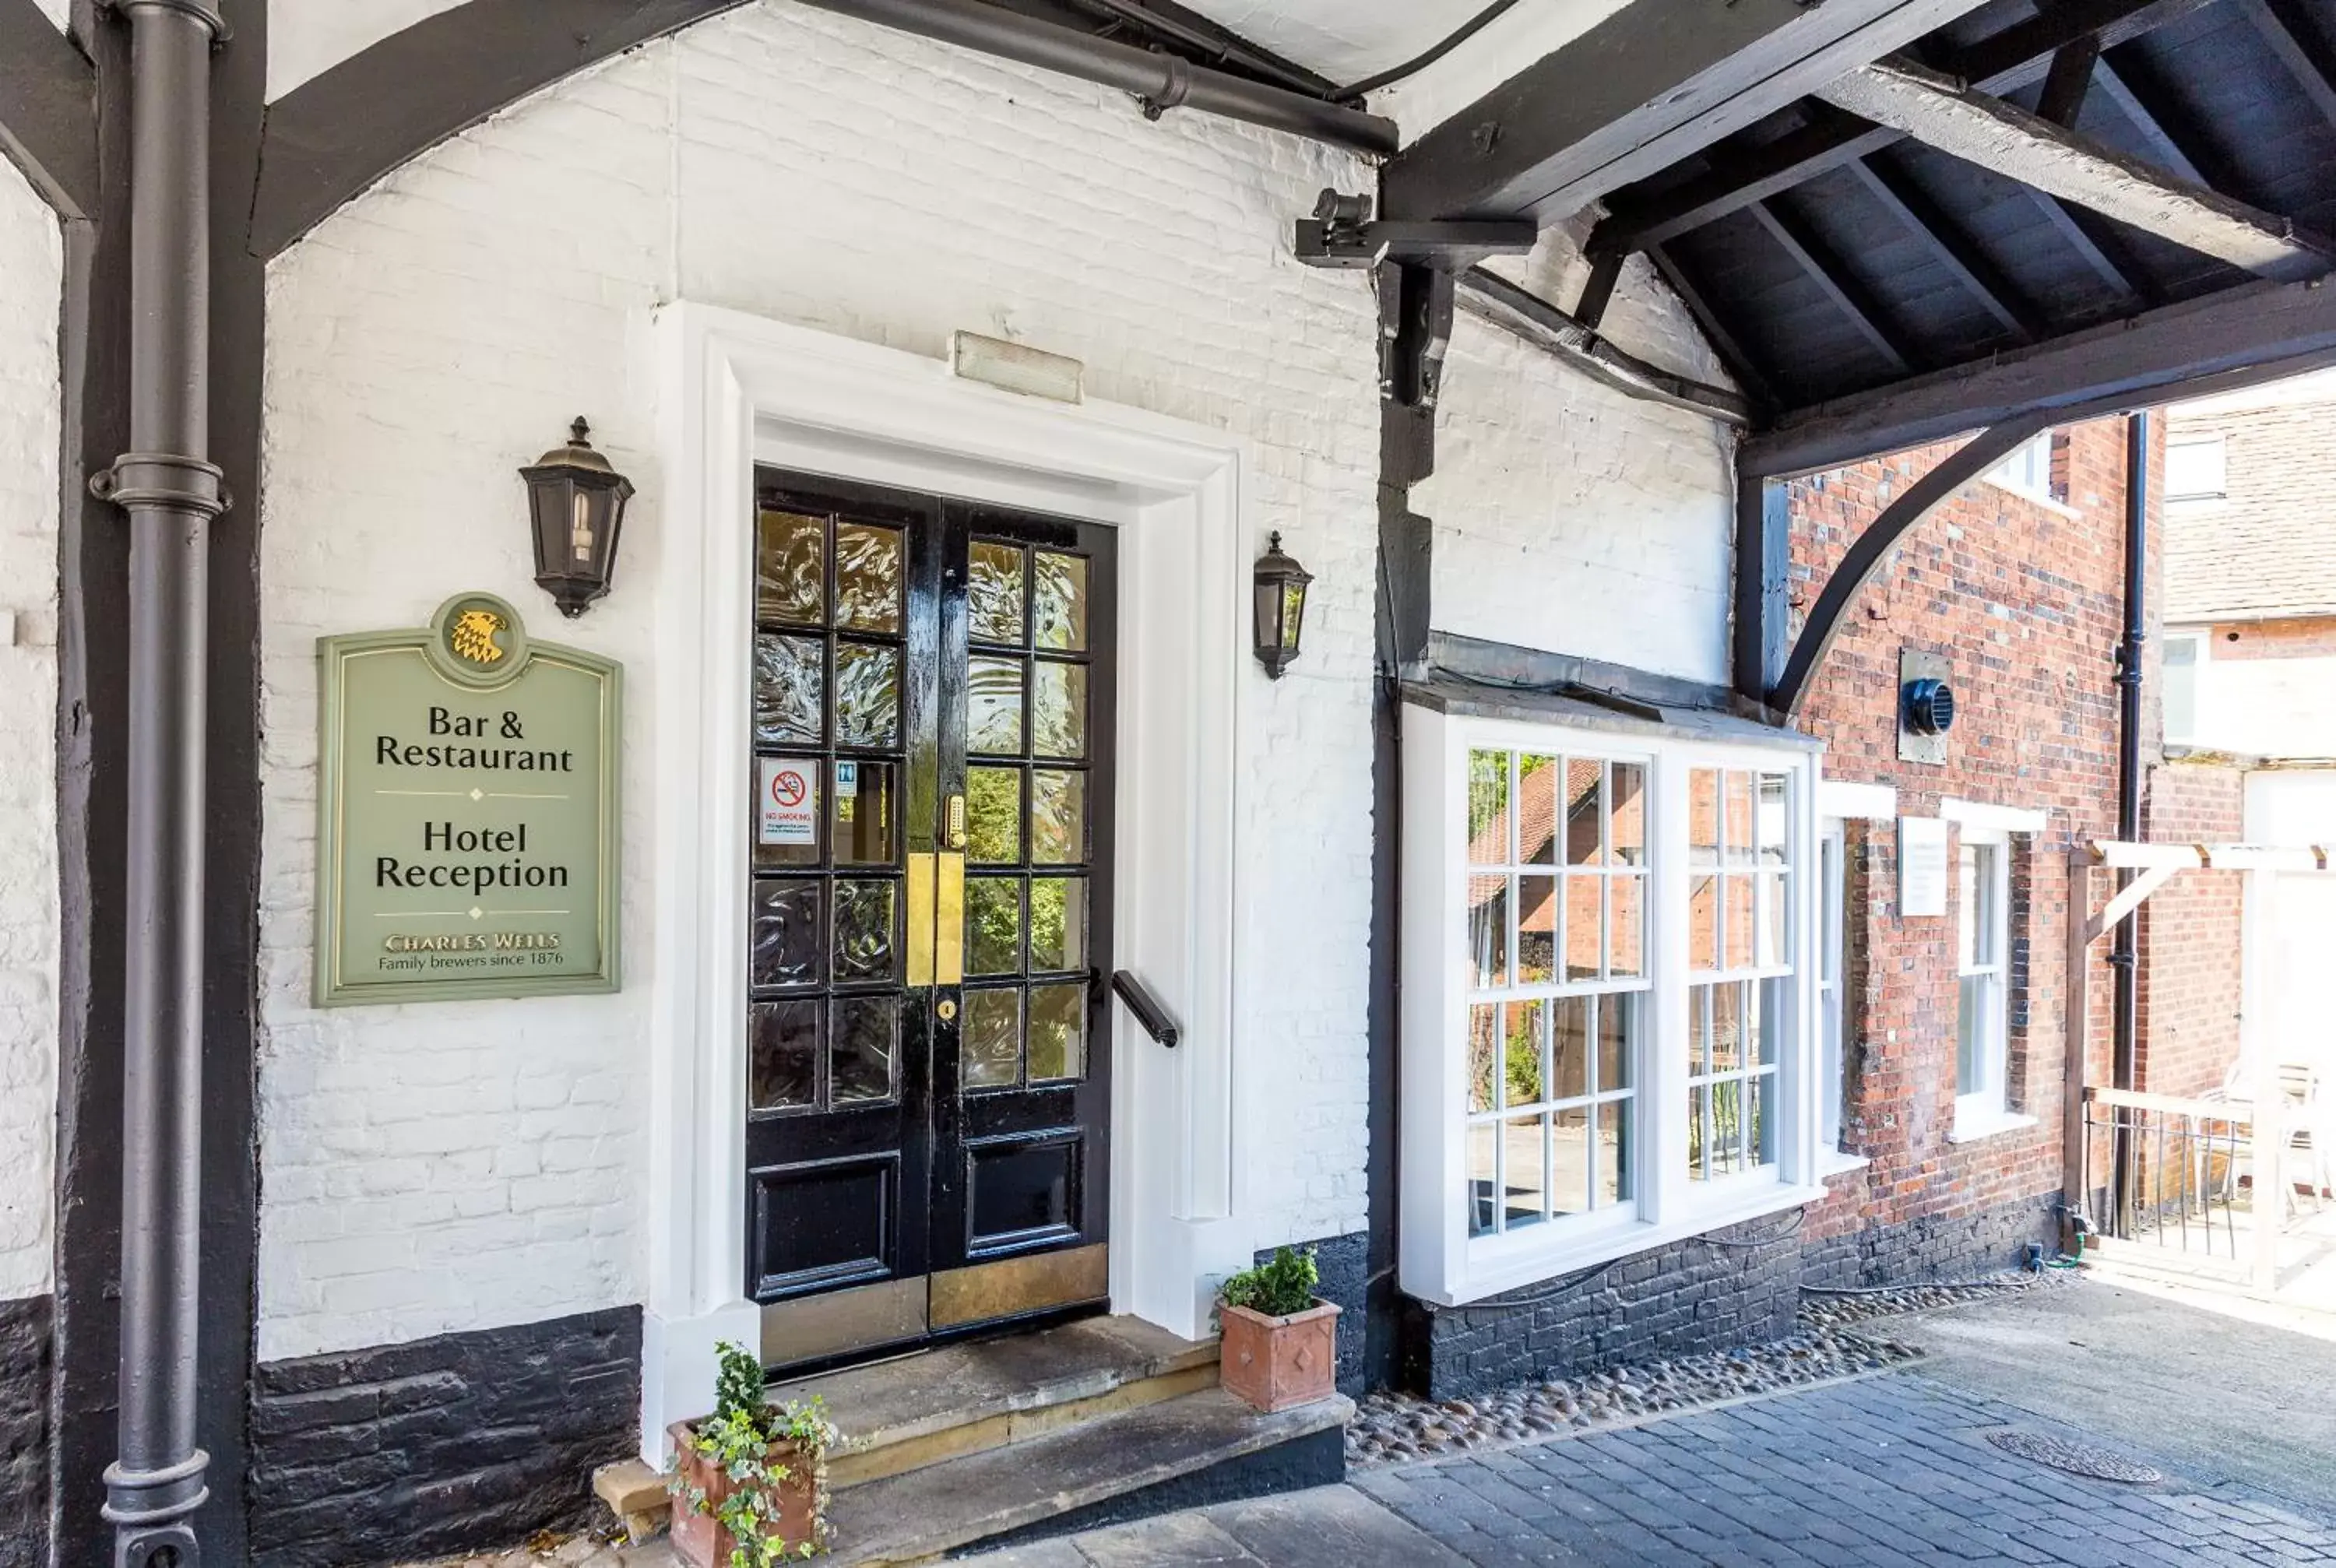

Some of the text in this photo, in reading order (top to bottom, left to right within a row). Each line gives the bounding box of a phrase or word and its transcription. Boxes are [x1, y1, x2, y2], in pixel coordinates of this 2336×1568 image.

[429, 706, 524, 740] Bar &
[377, 736, 573, 772] Restaurant
[778, 812, 811, 821] SMOKING
[424, 821, 526, 853] Hotel
[377, 856, 568, 896] Reception
[384, 933, 561, 952] CHARLES WELLS
[379, 952, 564, 972] Family brewers since 1876
